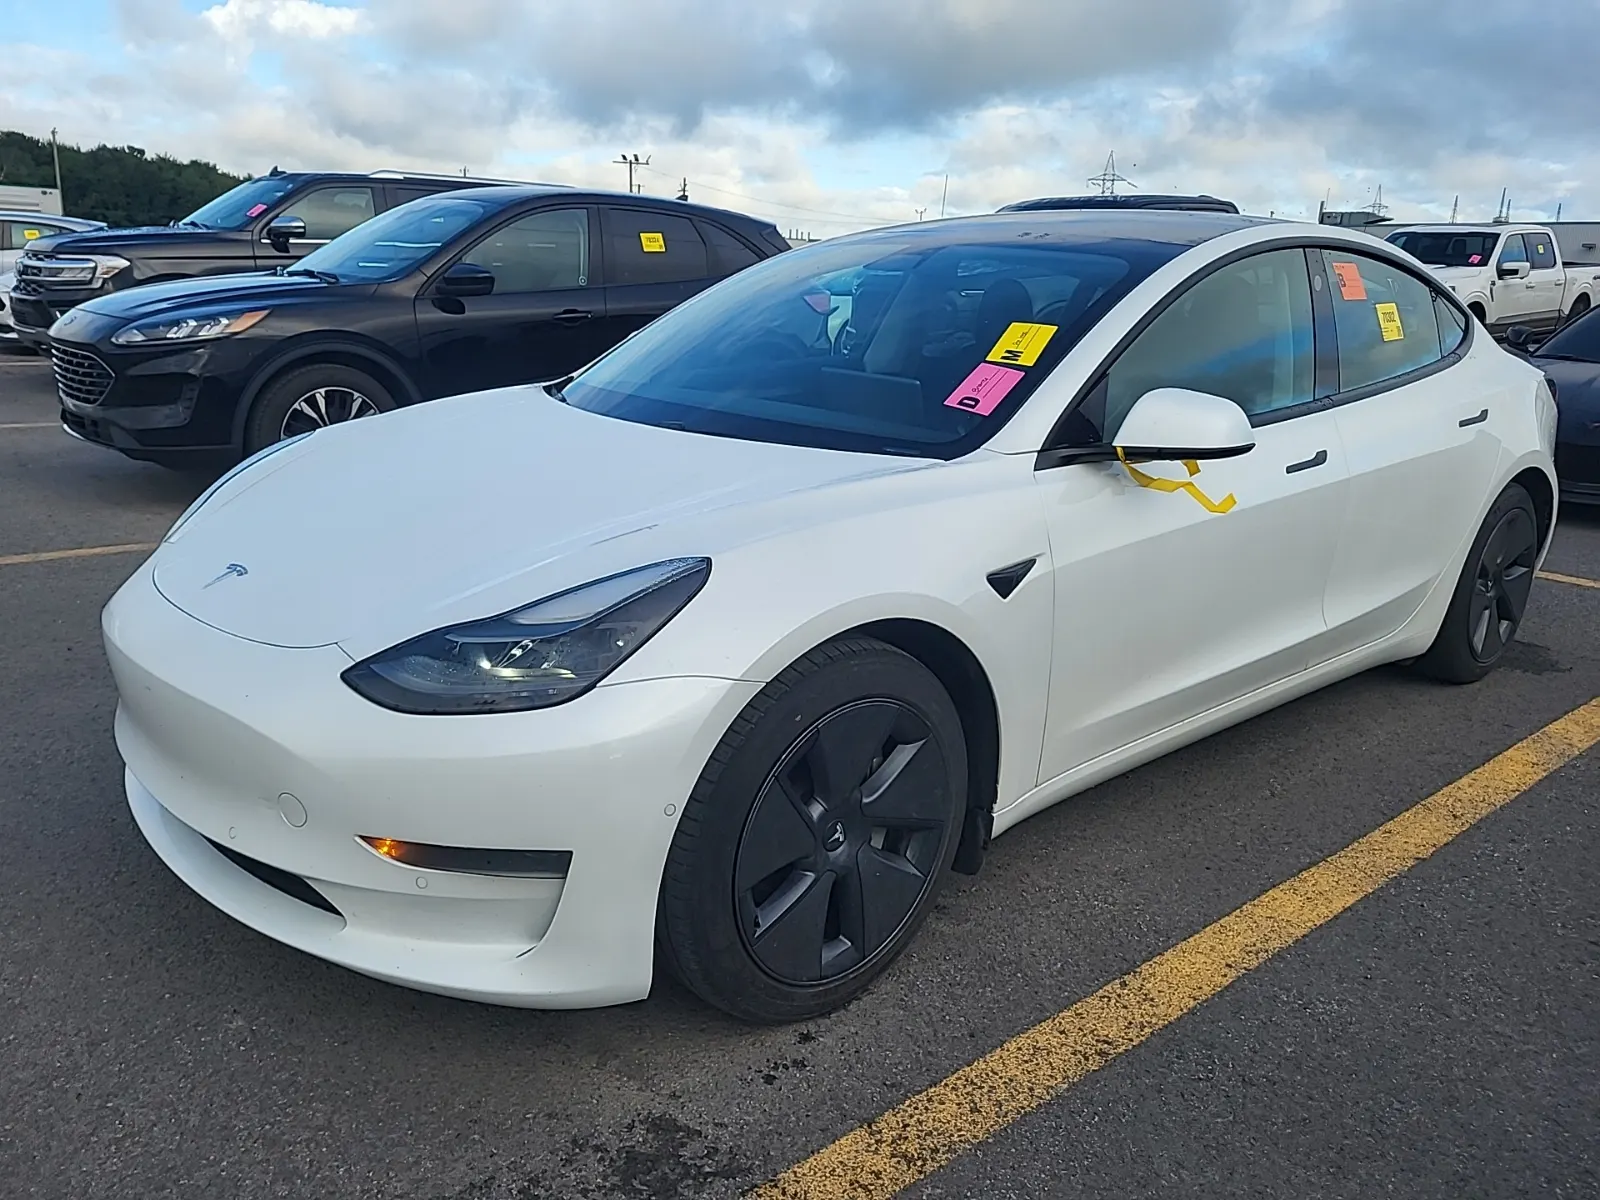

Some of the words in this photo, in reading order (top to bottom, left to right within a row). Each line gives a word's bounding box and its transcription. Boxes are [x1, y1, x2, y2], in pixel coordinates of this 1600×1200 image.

[1337, 272, 1347, 288] B
[1000, 349, 1024, 362] M
[956, 396, 981, 410] D
